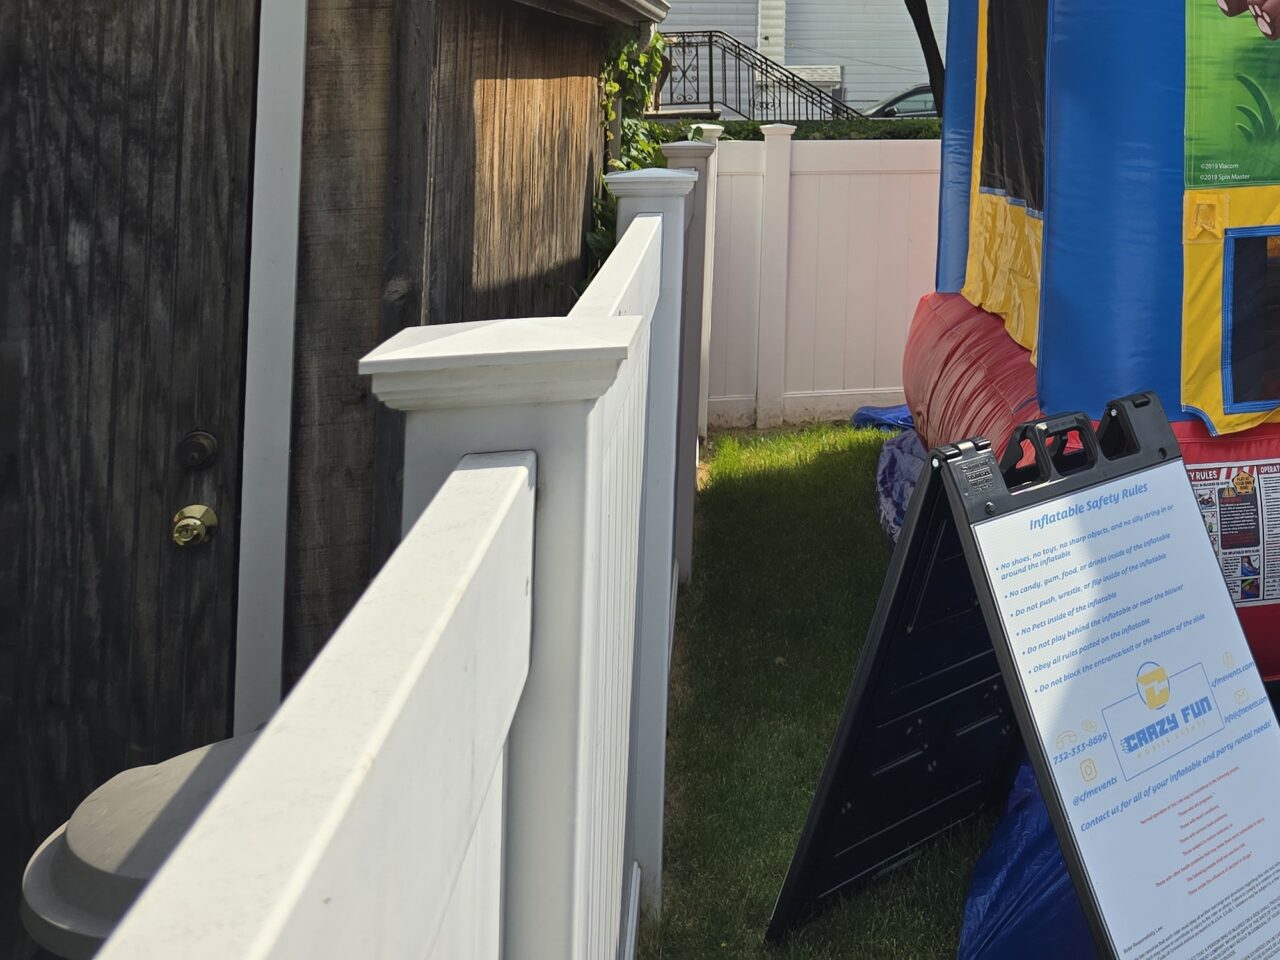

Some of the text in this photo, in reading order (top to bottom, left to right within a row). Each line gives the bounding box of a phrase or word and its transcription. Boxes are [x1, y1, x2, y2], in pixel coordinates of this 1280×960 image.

[1196, 470, 1218, 480] RULES
[1029, 483, 1148, 531] Inflatable Safety Rules
[1000, 562, 1011, 571] No
[1032, 551, 1042, 559] no
[1059, 541, 1069, 550] no
[1068, 535, 1087, 546] sharp
[1110, 521, 1123, 531] and
[1123, 519, 1132, 527] no
[1131, 515, 1144, 524] silly
[1143, 509, 1161, 520] string
[1000, 550, 1071, 581] around the inflatable
[1009, 589, 1020, 599] No
[1079, 564, 1088, 572] or
[1087, 556, 1108, 569] drinks
[1107, 549, 1125, 561] inside
[1125, 545, 1133, 554] of
[1132, 543, 1143, 552] the
[1143, 533, 1171, 548] inflatable
[1015, 608, 1026, 617] Do
[1025, 602, 1039, 613] not
[1083, 582, 1091, 590] or
[1091, 578, 1103, 589] flip
[1102, 570, 1121, 583] inside
[1120, 566, 1129, 576] of
[1128, 563, 1139, 573] the
[1139, 553, 1167, 568] inflatable
[1020, 591, 1117, 636] No Pets inside of the inflatable
[1027, 584, 1184, 655] Do not play behind the inflatable or near the blower
[1032, 617, 1151, 673] Obey all rules posted on the inflatable
[1039, 683, 1050, 693] Do
[1050, 676, 1063, 688] not
[1063, 668, 1082, 682] block
[1081, 663, 1094, 674] the
[1134, 641, 1142, 650] or
[1142, 636, 1153, 646] the
[1153, 626, 1176, 641] bottom
[1175, 622, 1183, 631] of
[1182, 619, 1193, 628] the
[1192, 613, 1206, 624] slide
[1210, 660, 1254, 687] cfmevents.com
[1052, 731, 1108, 765] 732-333-8699
[1122, 695, 1212, 754] CRAZY FUN
[1071, 774, 1118, 806] @cfmevents
[1080, 719, 1272, 833] Contact us for all of your inflatable and party rental needs!
